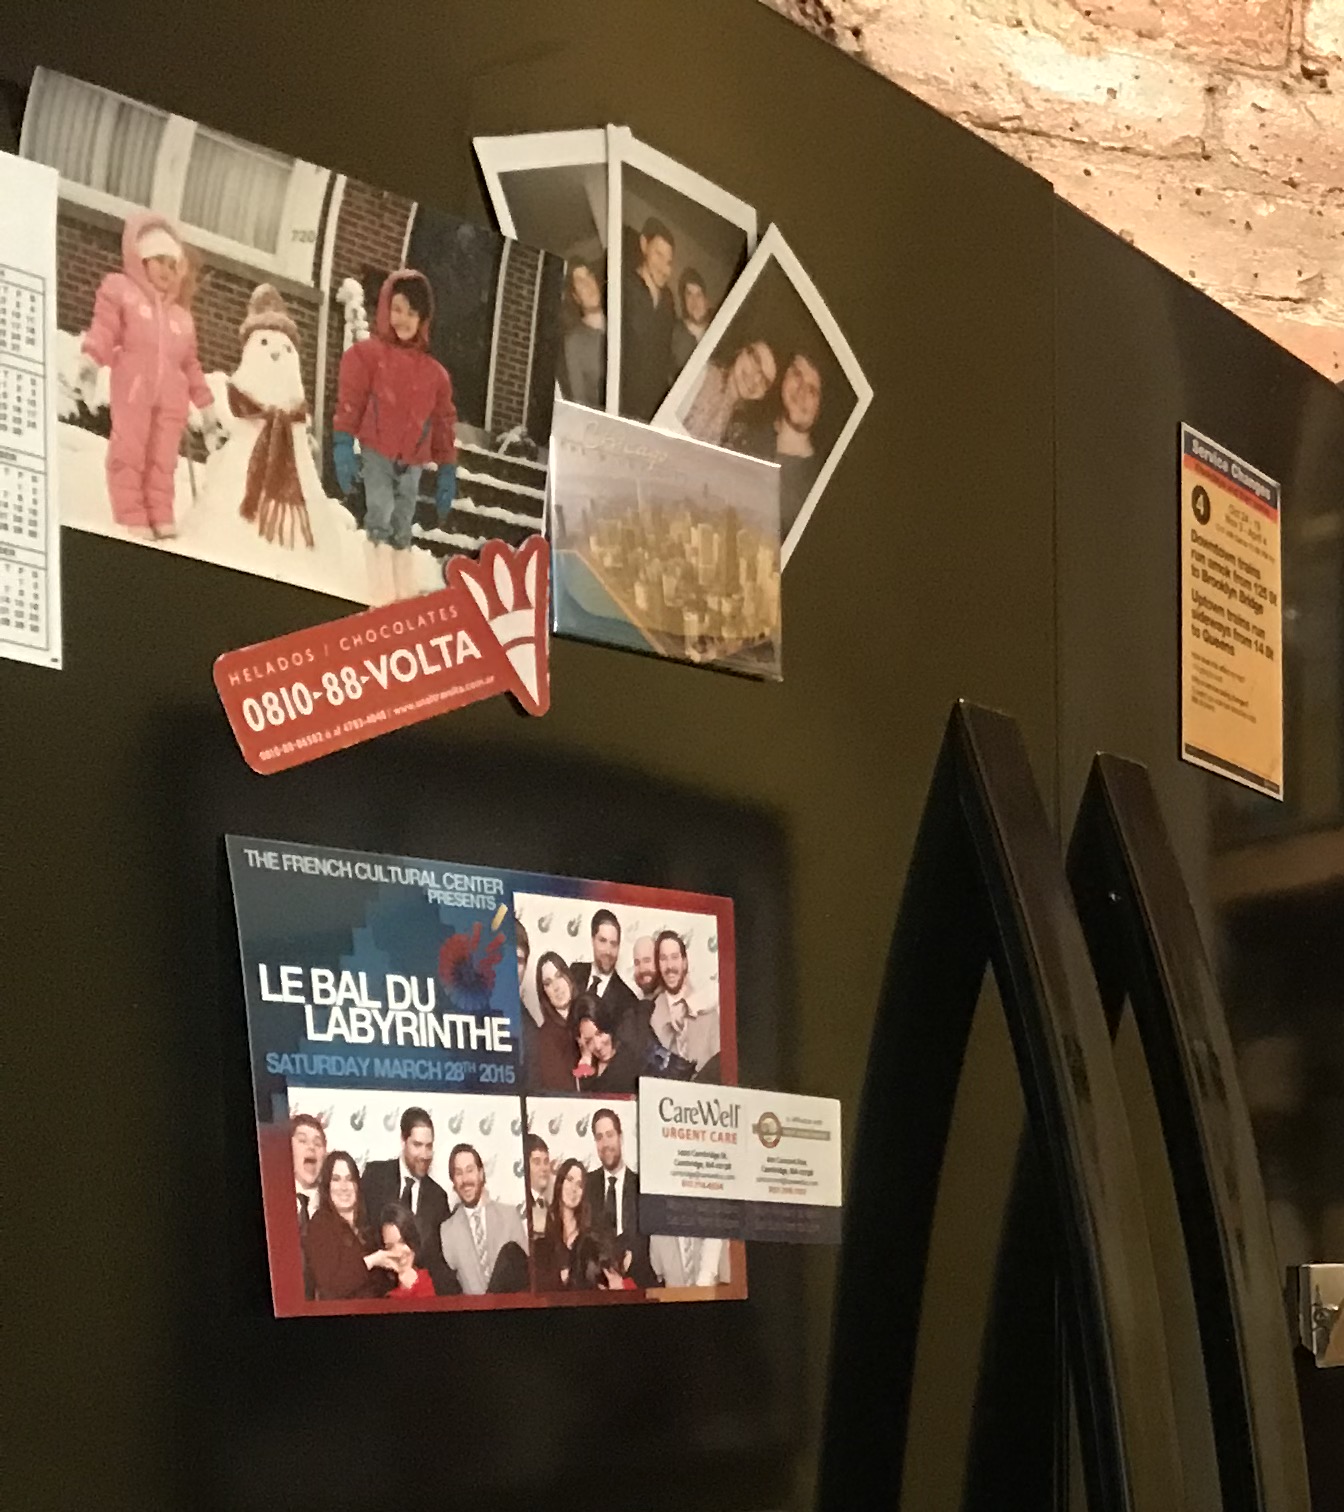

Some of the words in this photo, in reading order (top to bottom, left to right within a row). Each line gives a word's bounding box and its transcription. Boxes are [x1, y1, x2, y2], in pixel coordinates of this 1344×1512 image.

[229, 649, 315, 687] HELADOS
[339, 604, 459, 652] CHOCOLATES
[244, 848, 280, 871] THE
[282, 853, 353, 879] FRENCH
[354, 861, 442, 890] CULTURAL
[442, 871, 505, 896] CENTER
[427, 888, 497, 911] PRESENTS
[258, 962, 306, 1004] LE
[310, 966, 382, 1010] BAL
[386, 973, 437, 1013] DU
[304, 1003, 514, 1053] LABYRINTHE
[265, 1052, 371, 1077] SATURDAY
[374, 1056, 442, 1081] MARCH
[479, 1063, 516, 1084] 2015
[658, 1096, 740, 1129] CareWell
[662, 1127, 706, 1143] URGENT
[710, 1130, 738, 1145] CARE
